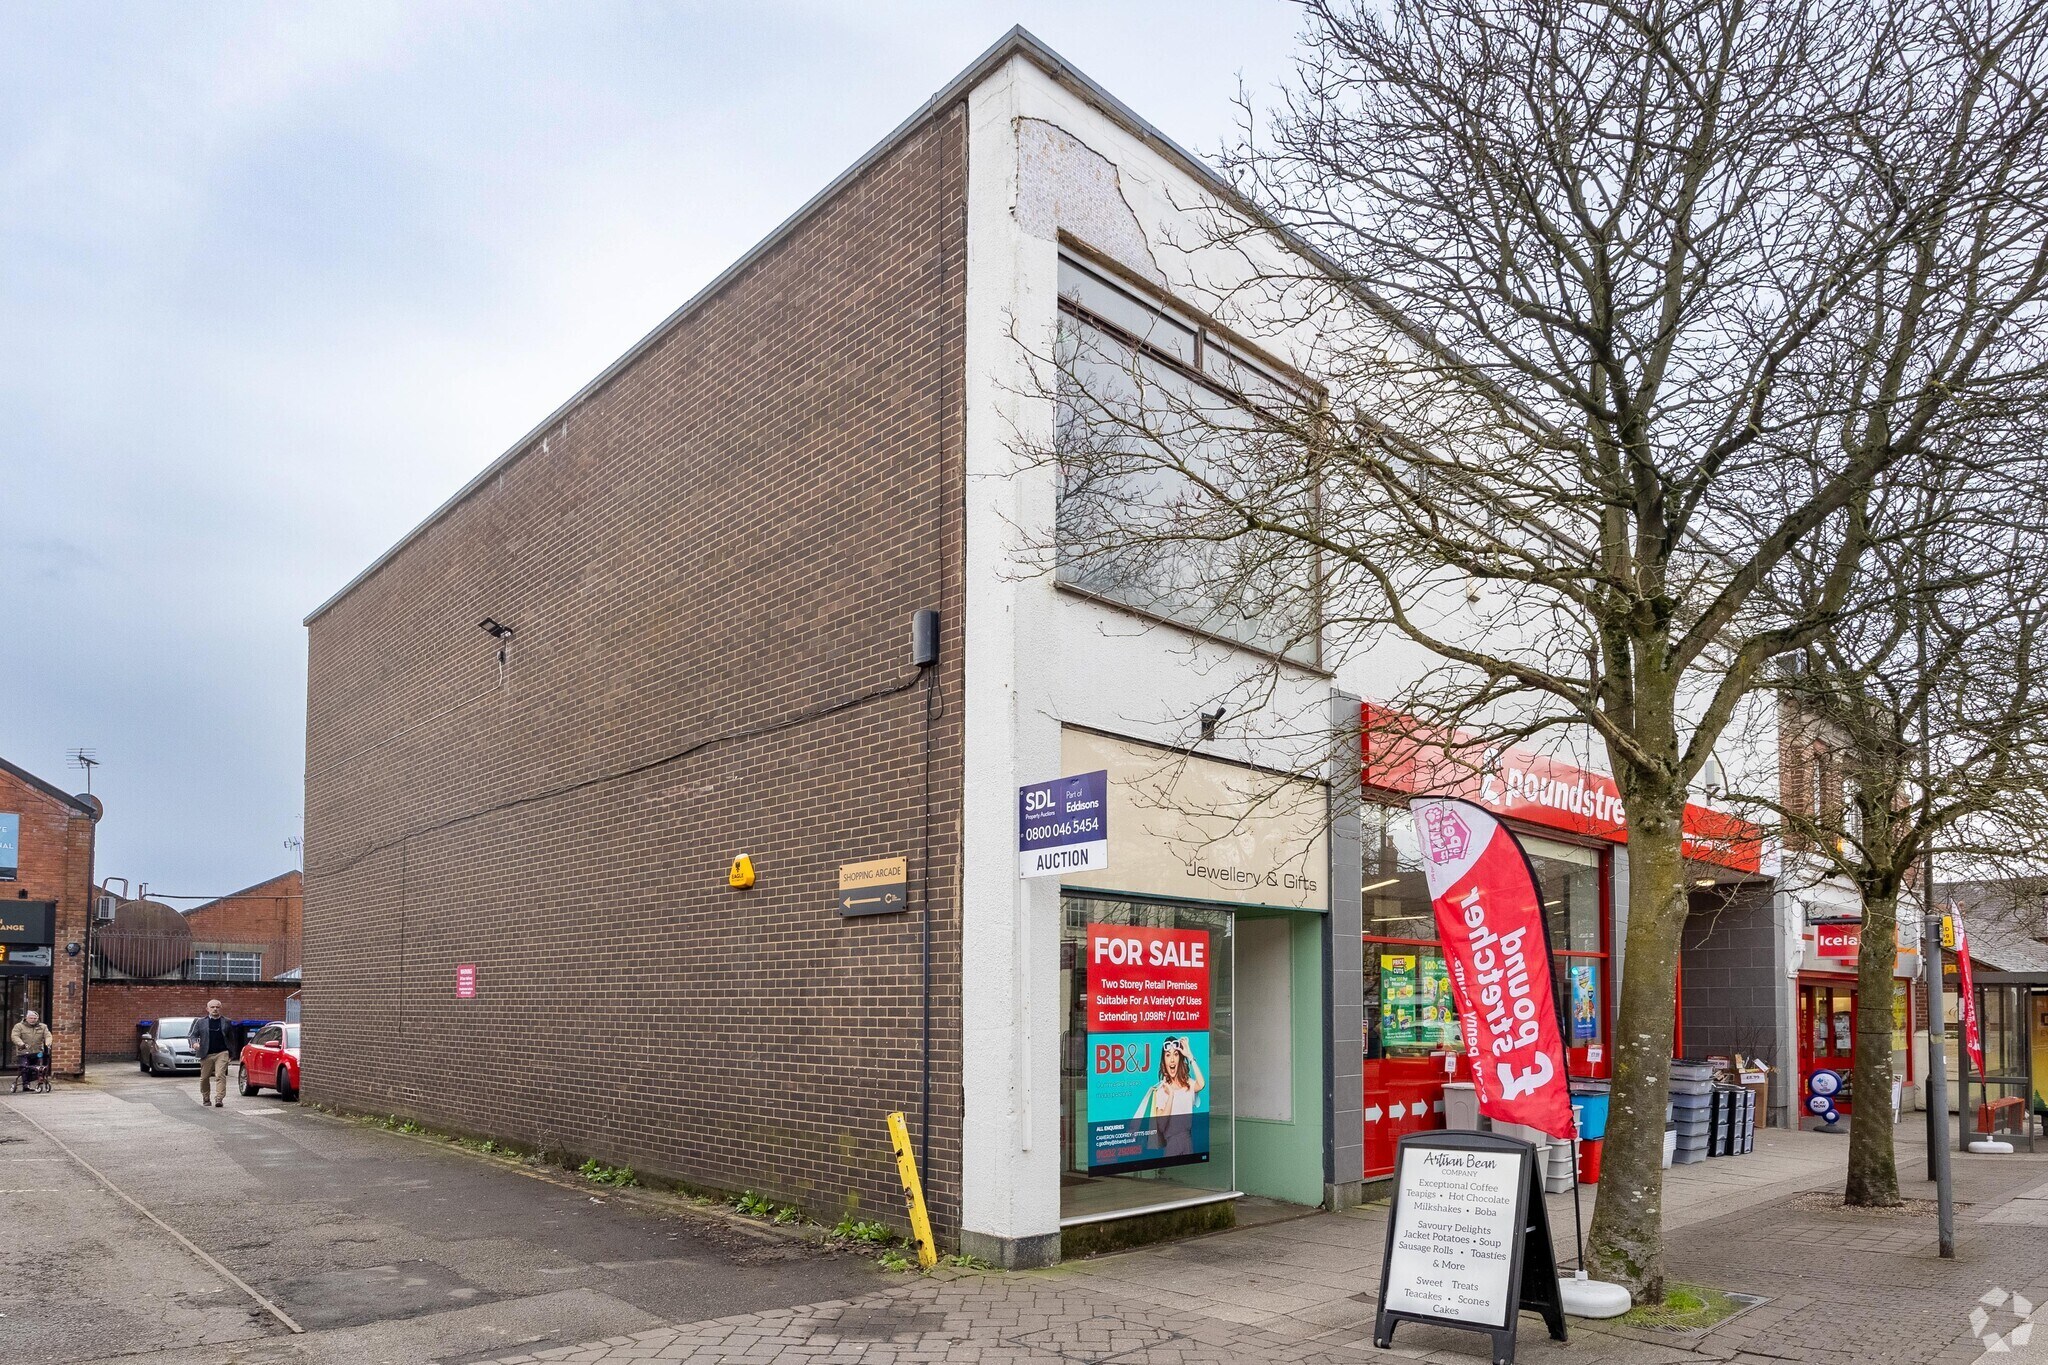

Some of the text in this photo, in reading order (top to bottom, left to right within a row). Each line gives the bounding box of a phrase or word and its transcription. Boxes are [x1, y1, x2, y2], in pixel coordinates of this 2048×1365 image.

[1025, 788, 1056, 812] SDL
[1066, 788, 1083, 799] Part of
[1066, 800, 1099, 813] Eddisons
[1026, 817, 1099, 841] 0800 046 5454
[1036, 848, 1089, 871] AUCTION
[843, 866, 901, 882] SHOPPING ARCADE
[1186, 861, 1317, 892] Jewellery & Gifts
[1820, 935, 1858, 946] Icela
[1094, 936, 1205, 968] FOR SALE
[1101, 978, 1198, 991] Two Storey Retail Premises
[1096, 995, 1202, 1007] Suitable For A Variety Of Uses
[1099, 1011, 1138, 1023] Extending
[1167, 1012, 1171, 1022] /
[1096, 1043, 1151, 1074] BB&J
[1423, 1151, 1497, 1169] Artisan Bean
[1441, 1168, 1478, 1177] COMPANY
[1419, 1178, 1499, 1192] Exceptional Coffee
[1406, 1188, 1510, 1204] Teapigs Hot Chocolate
[1414, 1201, 1497, 1217] Milkshakes Boba
[1417, 1220, 1492, 1235] Savoury Delights
[1403, 1229, 1502, 1249] Jacket Potatoes Soup
[1398, 1241, 1507, 1261] Sausage Rolls Toasties
[1432, 1259, 1466, 1271] & More
[1416, 1276, 1479, 1291] Sweet Treats
[1404, 1288, 1490, 1307] Teacakes Scones
[1432, 1304, 1459, 1315] Cakes
